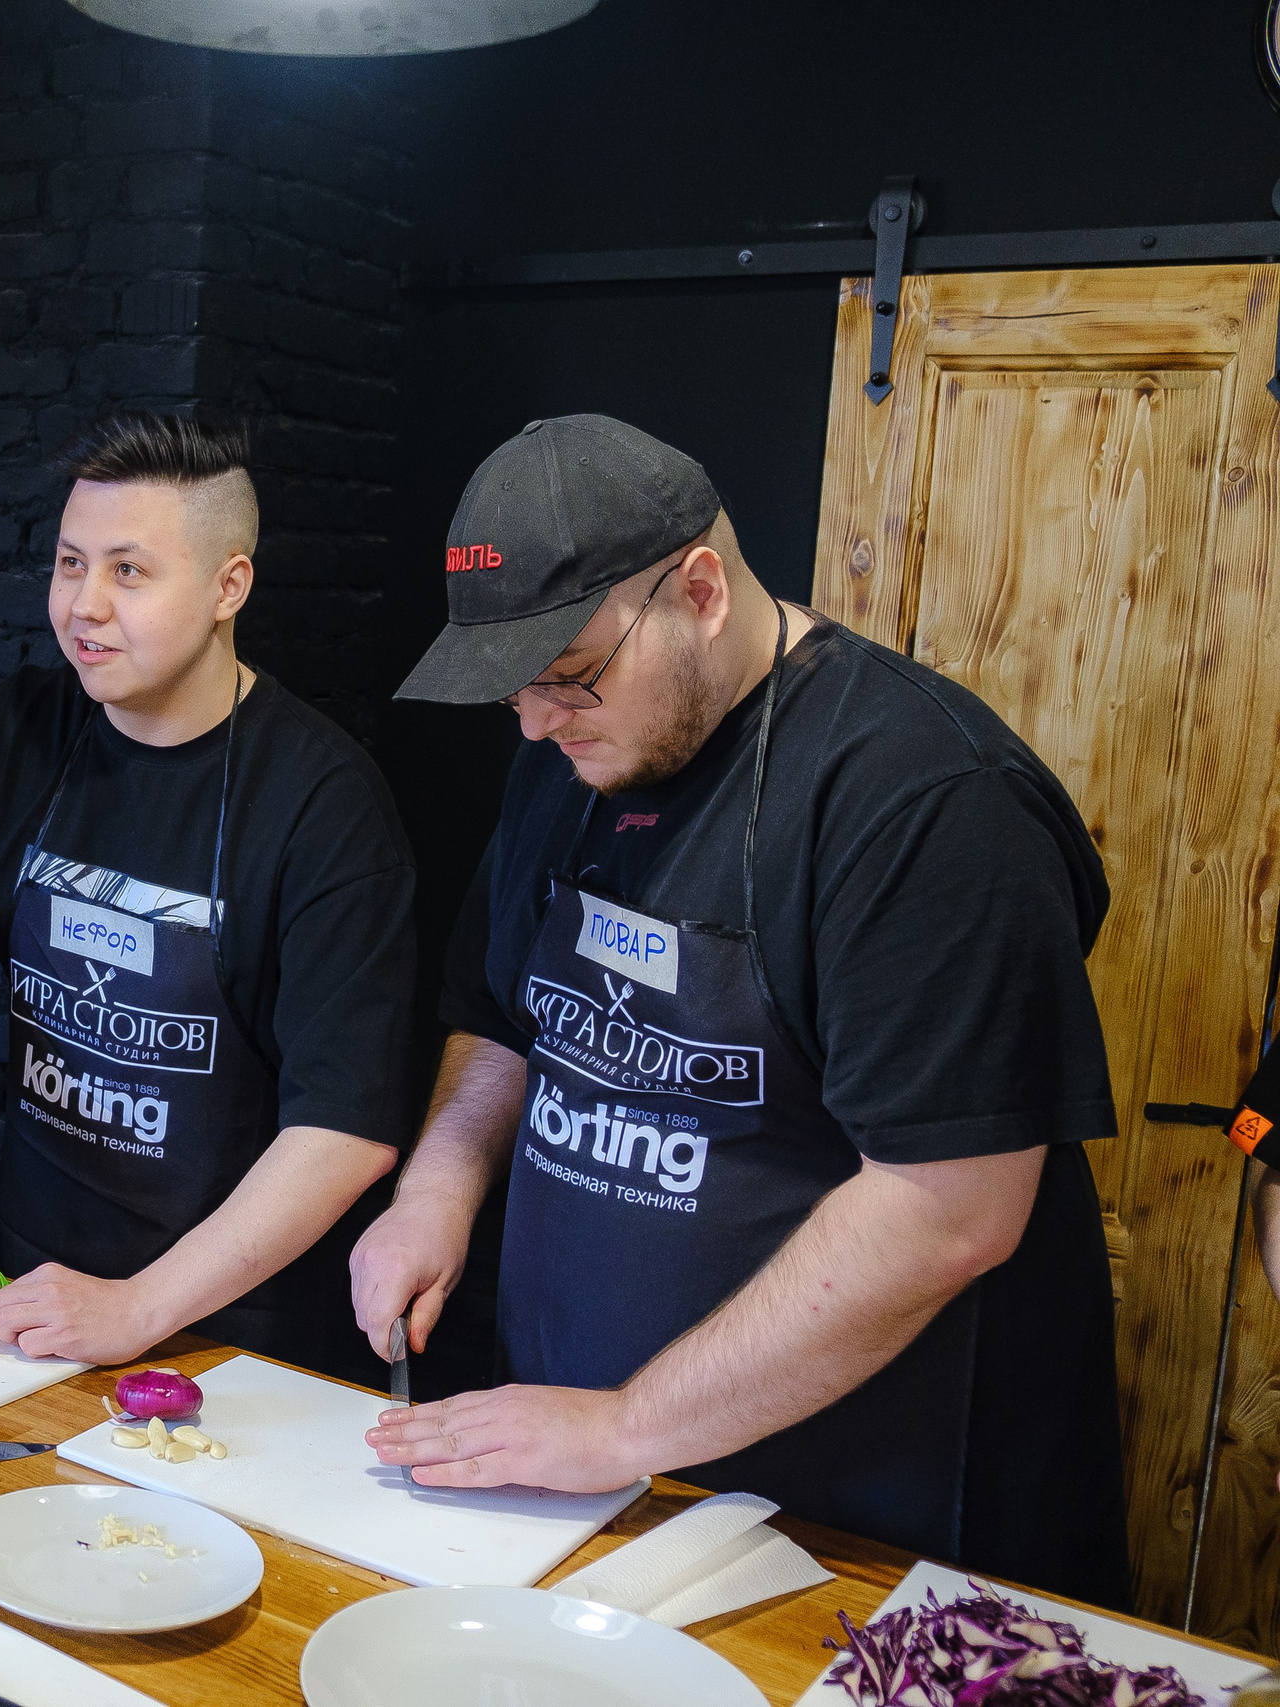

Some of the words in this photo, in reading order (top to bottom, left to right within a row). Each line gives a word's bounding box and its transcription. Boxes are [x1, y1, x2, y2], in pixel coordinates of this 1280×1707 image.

[590, 913, 666, 963] ПОВАР
[12, 967, 67, 1021] ИГРА
[73, 1000, 206, 1053] СТОЛОВ
[32, 1010, 100, 1047] КУЛИНАРНАЯ
[105, 1042, 160, 1062] СТУДИЯ
[530, 986, 595, 1048] ИГРА
[602, 1021, 749, 1084] СТОЛОВ
[543, 1033, 617, 1077] КУЛИНАРНАЯ
[22, 1043, 169, 1143] körting
[104, 1077, 131, 1091] since
[134, 1083, 160, 1097] 1889
[20, 1098, 97, 1145] встраиваемая
[101, 1135, 164, 1159] техника
[529, 1073, 709, 1193] körting
[627, 1106, 660, 1124] since
[665, 1113, 699, 1130] 1889
[524, 1143, 609, 1196] встраиваемая
[615, 1183, 698, 1214] техника
